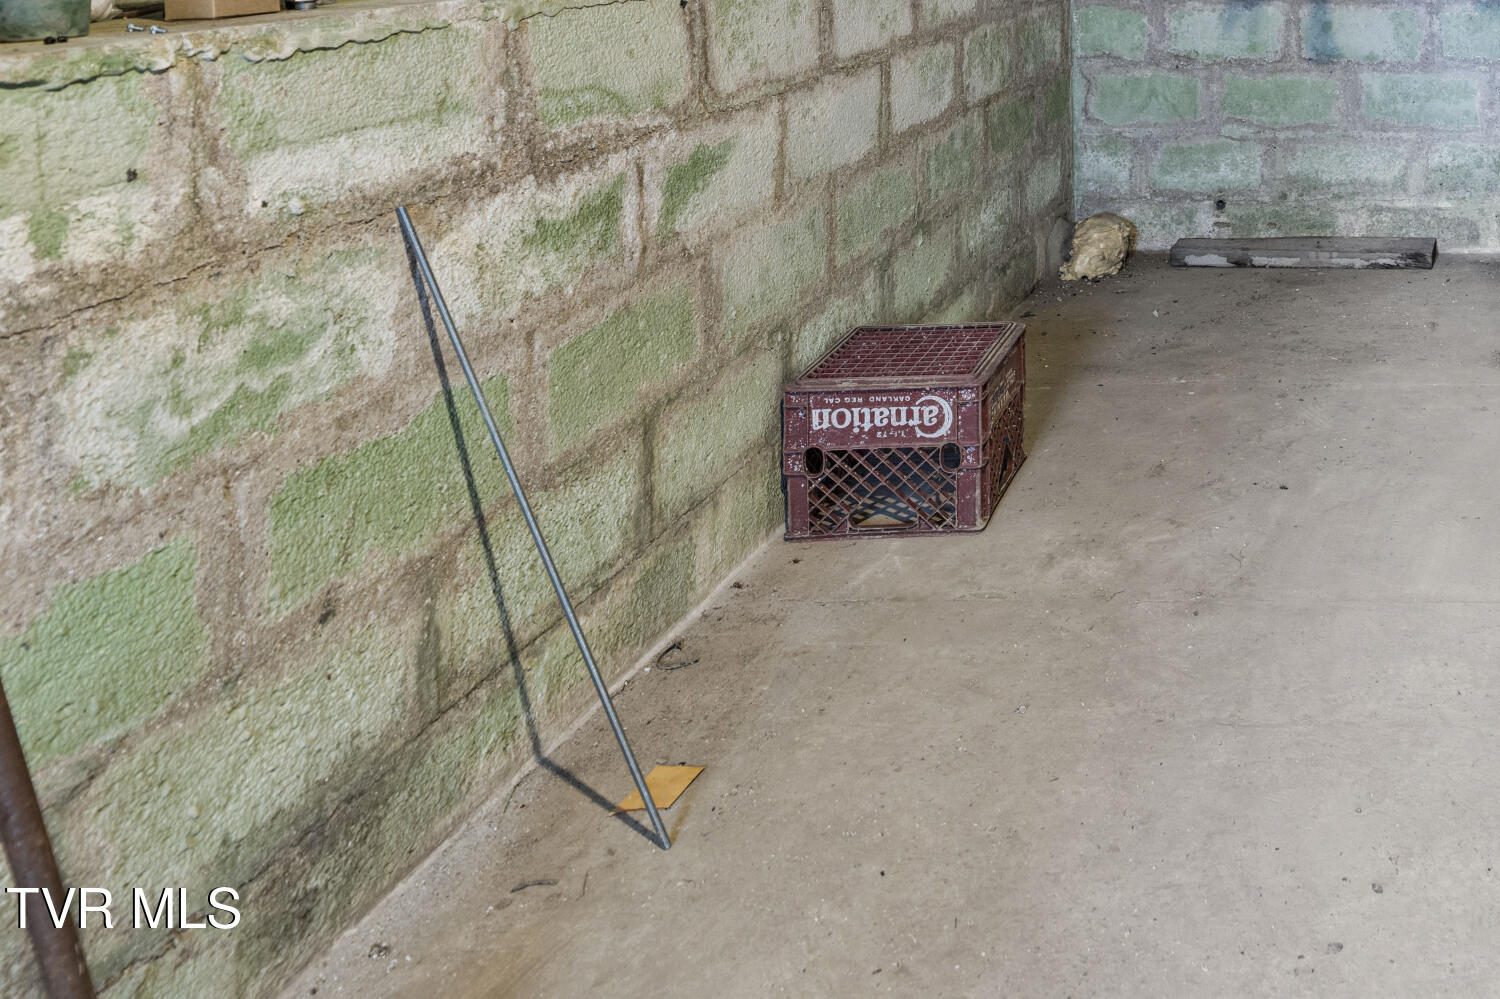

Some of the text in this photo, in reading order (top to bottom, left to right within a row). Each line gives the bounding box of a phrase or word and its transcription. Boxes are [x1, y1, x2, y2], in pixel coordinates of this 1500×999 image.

[844, 396, 863, 404] REG
[869, 395, 911, 403] OAKLAND
[811, 395, 953, 439] Carnation
